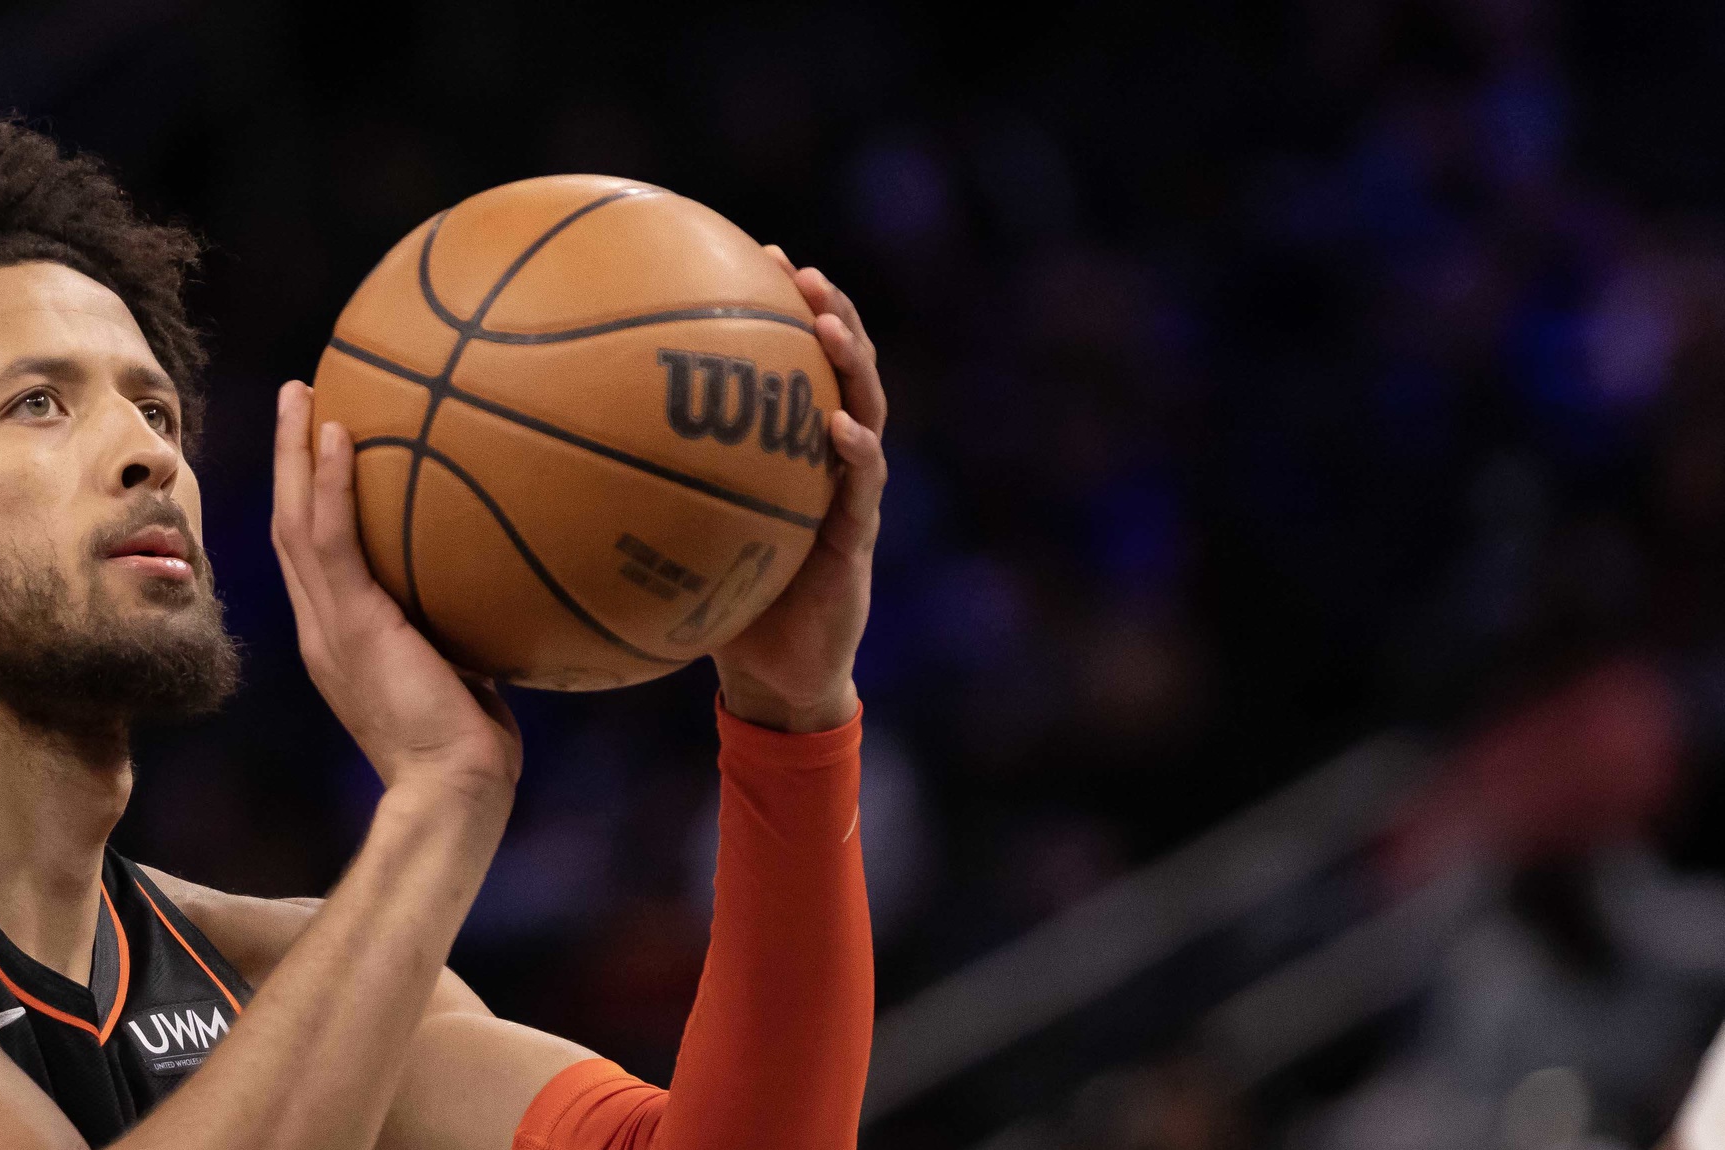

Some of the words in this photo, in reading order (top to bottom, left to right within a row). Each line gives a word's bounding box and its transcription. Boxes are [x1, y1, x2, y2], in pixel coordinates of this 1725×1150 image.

[656, 347, 836, 476] Wils
[128, 1005, 229, 1054] UWM
[154, 1061, 175, 1070] UNITED
